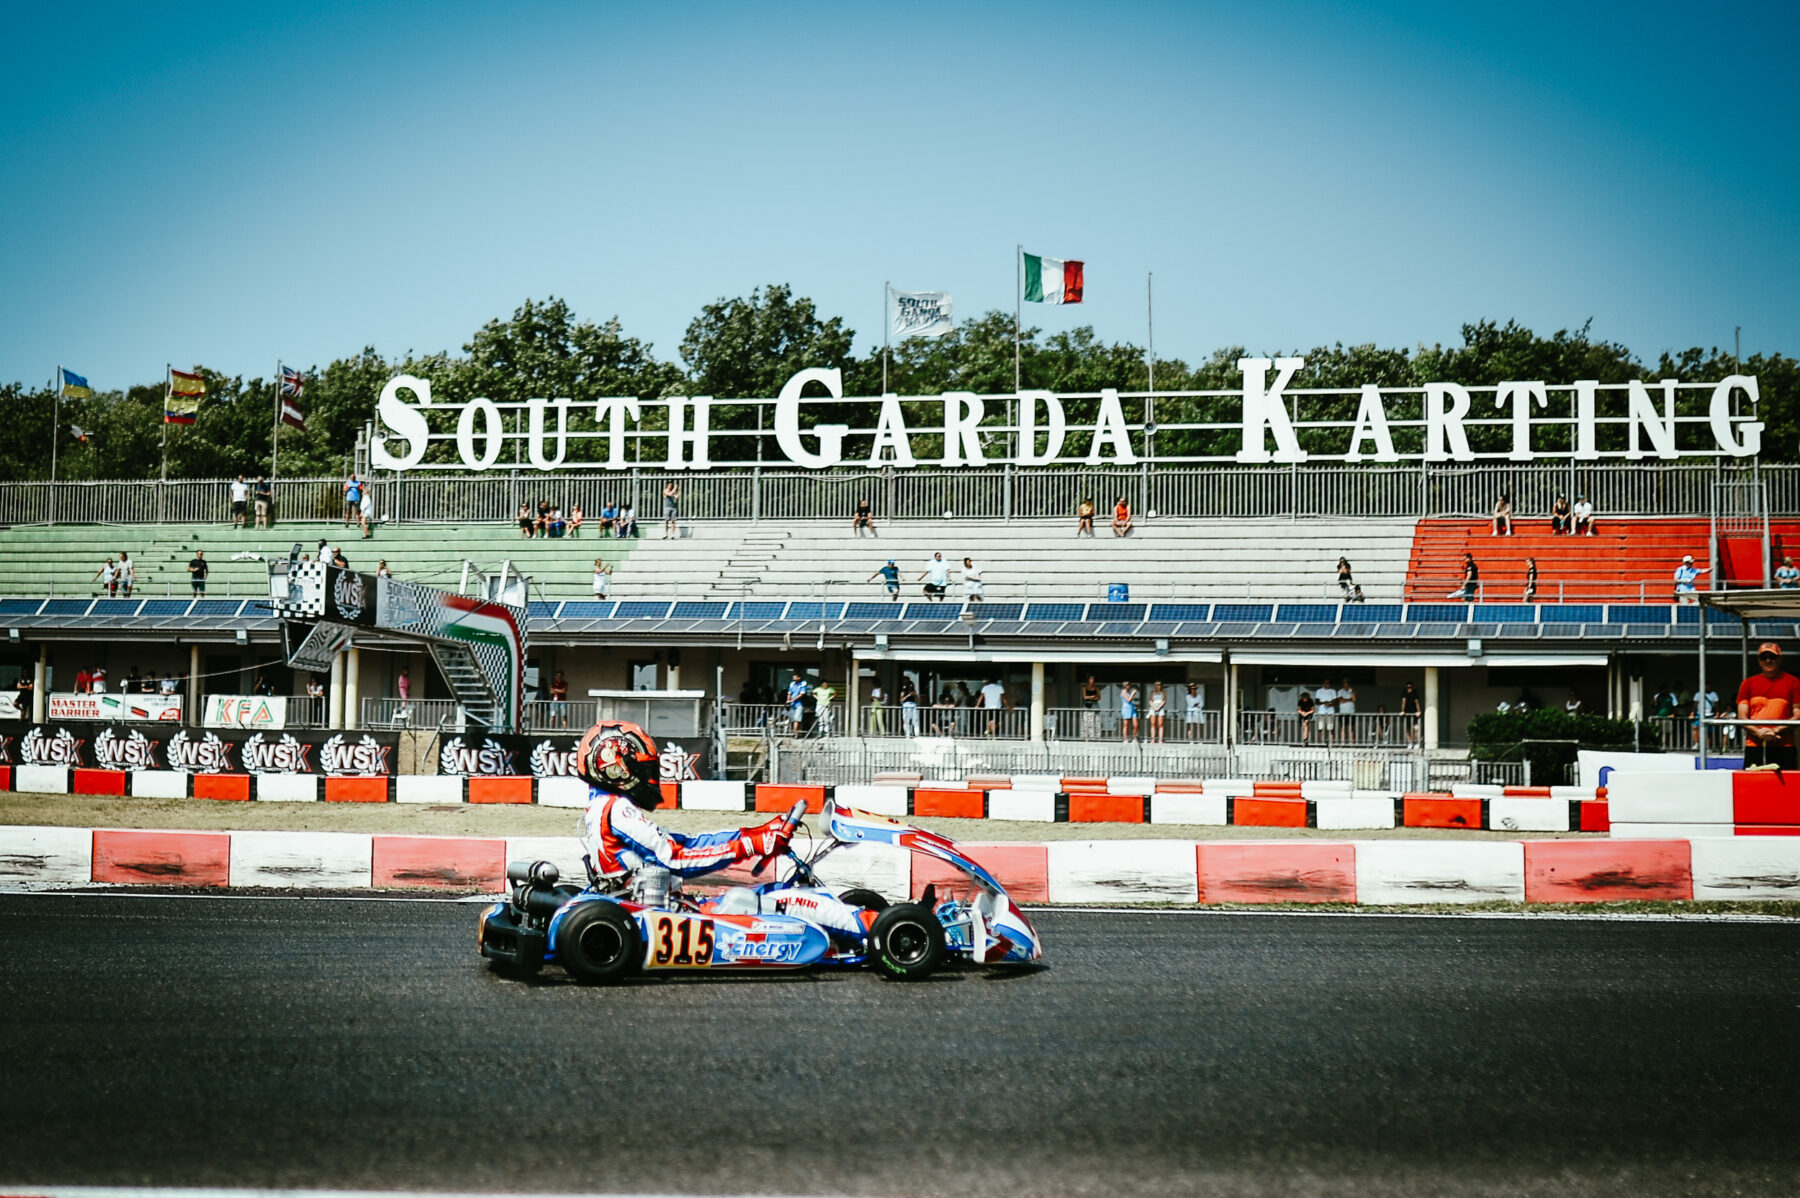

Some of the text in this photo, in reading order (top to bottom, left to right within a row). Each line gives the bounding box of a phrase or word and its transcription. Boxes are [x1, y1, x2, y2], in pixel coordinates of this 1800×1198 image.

[371, 357, 1766, 471] SOUTH GARDA KARTING
[50, 699, 96, 708] MASTER
[50, 708, 100, 717] BARRIER
[216, 698, 274, 722] KFA
[29, 738, 85, 766] WSK
[102, 739, 159, 767] WSK
[176, 741, 234, 770] WSK
[251, 743, 312, 772] WSK
[330, 745, 391, 774] WSK
[451, 749, 519, 775] WSK
[540, 752, 579, 776] WS
[659, 752, 701, 780] SK
[656, 917, 714, 965] 315
[732, 932, 802, 961] Energy
